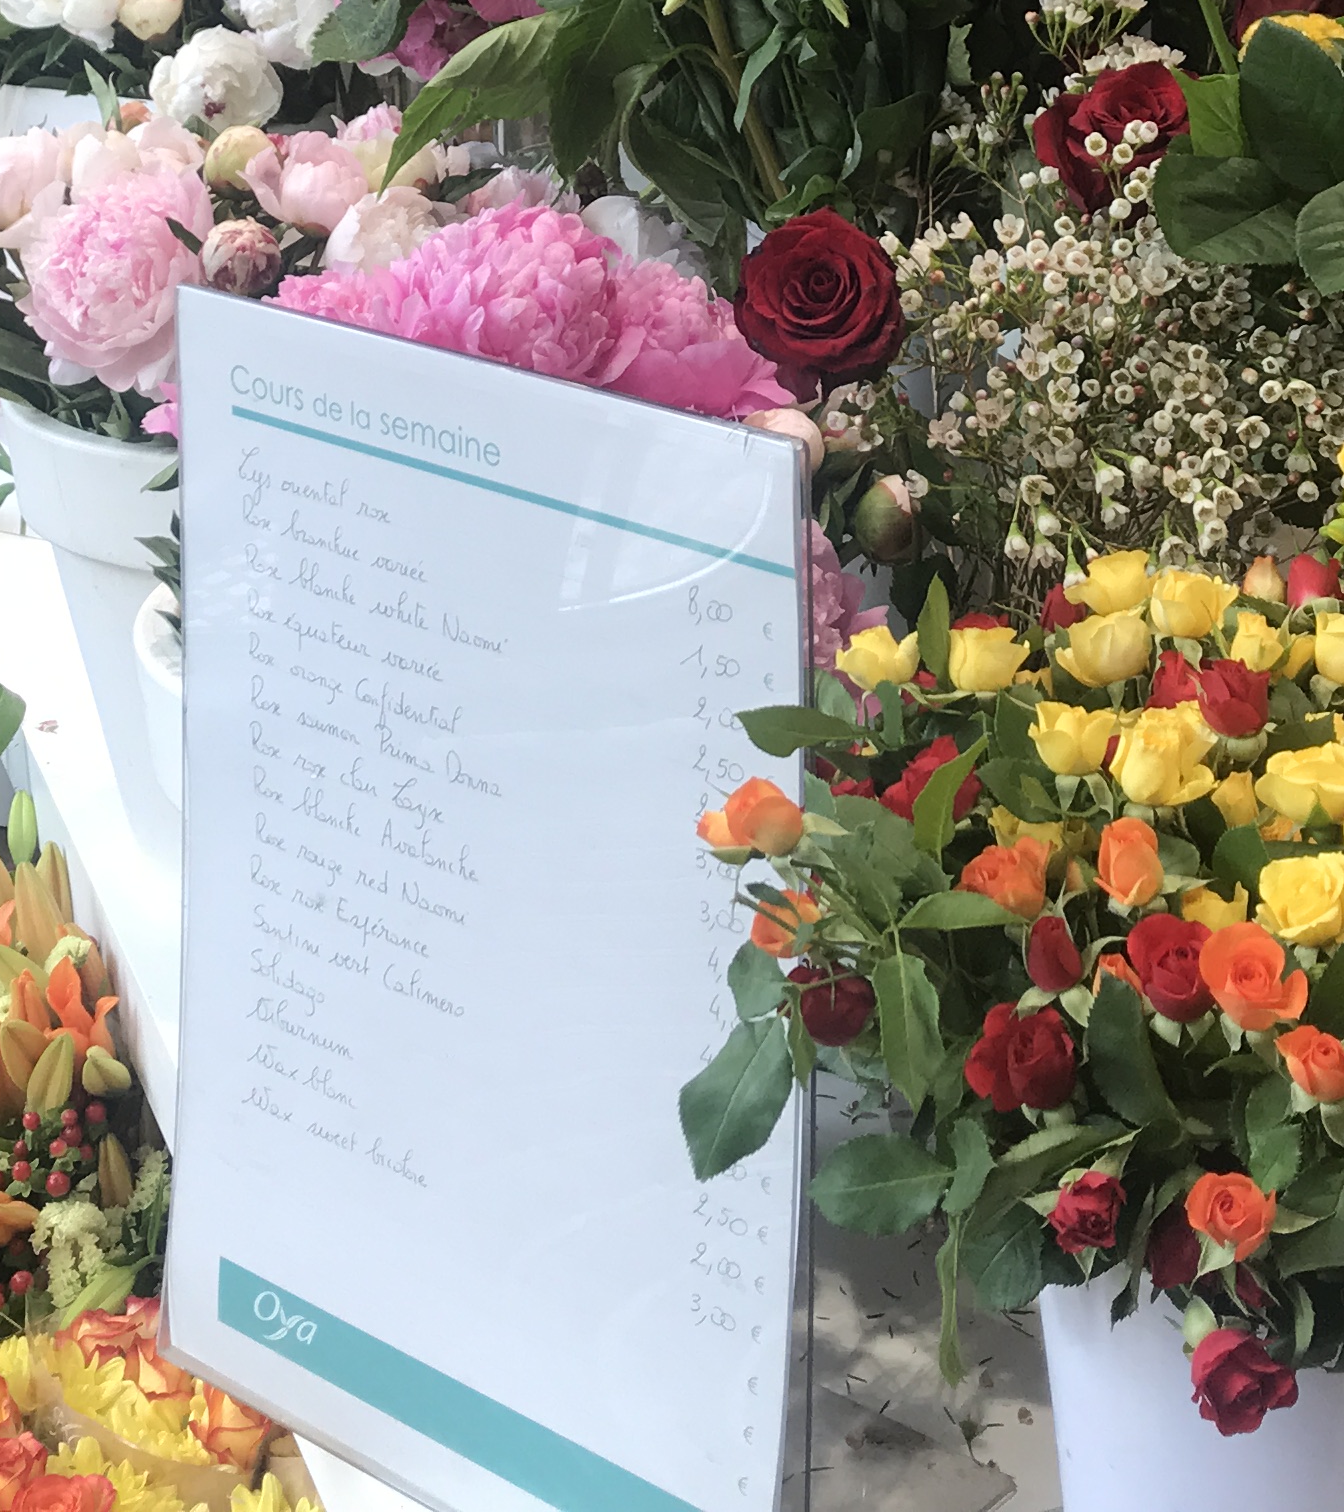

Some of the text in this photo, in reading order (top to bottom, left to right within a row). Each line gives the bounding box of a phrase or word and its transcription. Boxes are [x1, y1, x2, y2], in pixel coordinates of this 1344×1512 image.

[230, 364, 501, 467] Cours de la semaine
[688, 584, 775, 642] 8,00 €
[678, 643, 775, 692] 1,50 €
[355, 870, 389, 896] red
[692, 1191, 749, 1237] 2,50
[253, 1290, 318, 1346] Oya
